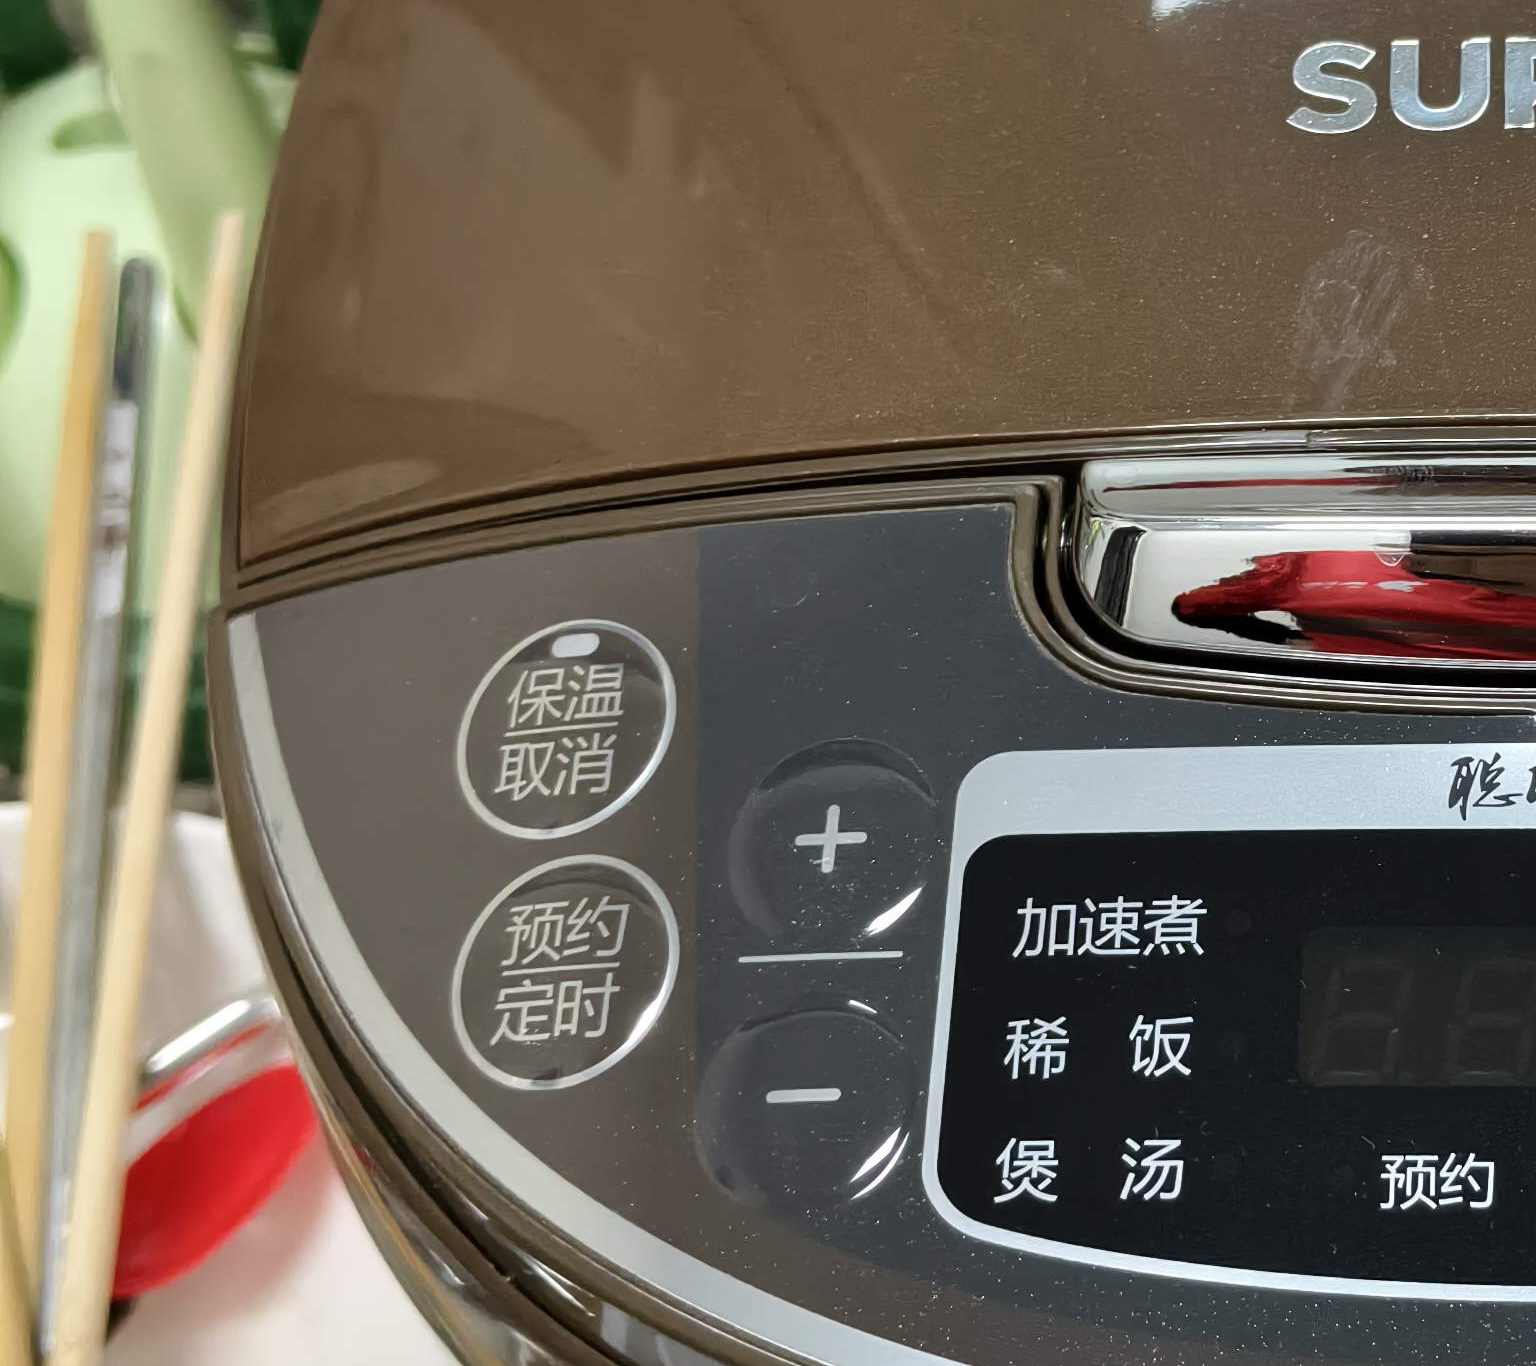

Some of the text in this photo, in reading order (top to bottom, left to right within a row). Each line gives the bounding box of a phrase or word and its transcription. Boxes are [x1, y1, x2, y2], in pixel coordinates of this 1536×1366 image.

[506, 662, 625, 728] 保温
[494, 733, 618, 801] 取消
[501, 895, 631, 967] 预约
[1011, 894, 1208, 958] 加速煮
[490, 973, 621, 1045] 定时
[1379, 1152, 1496, 1210] 预约
